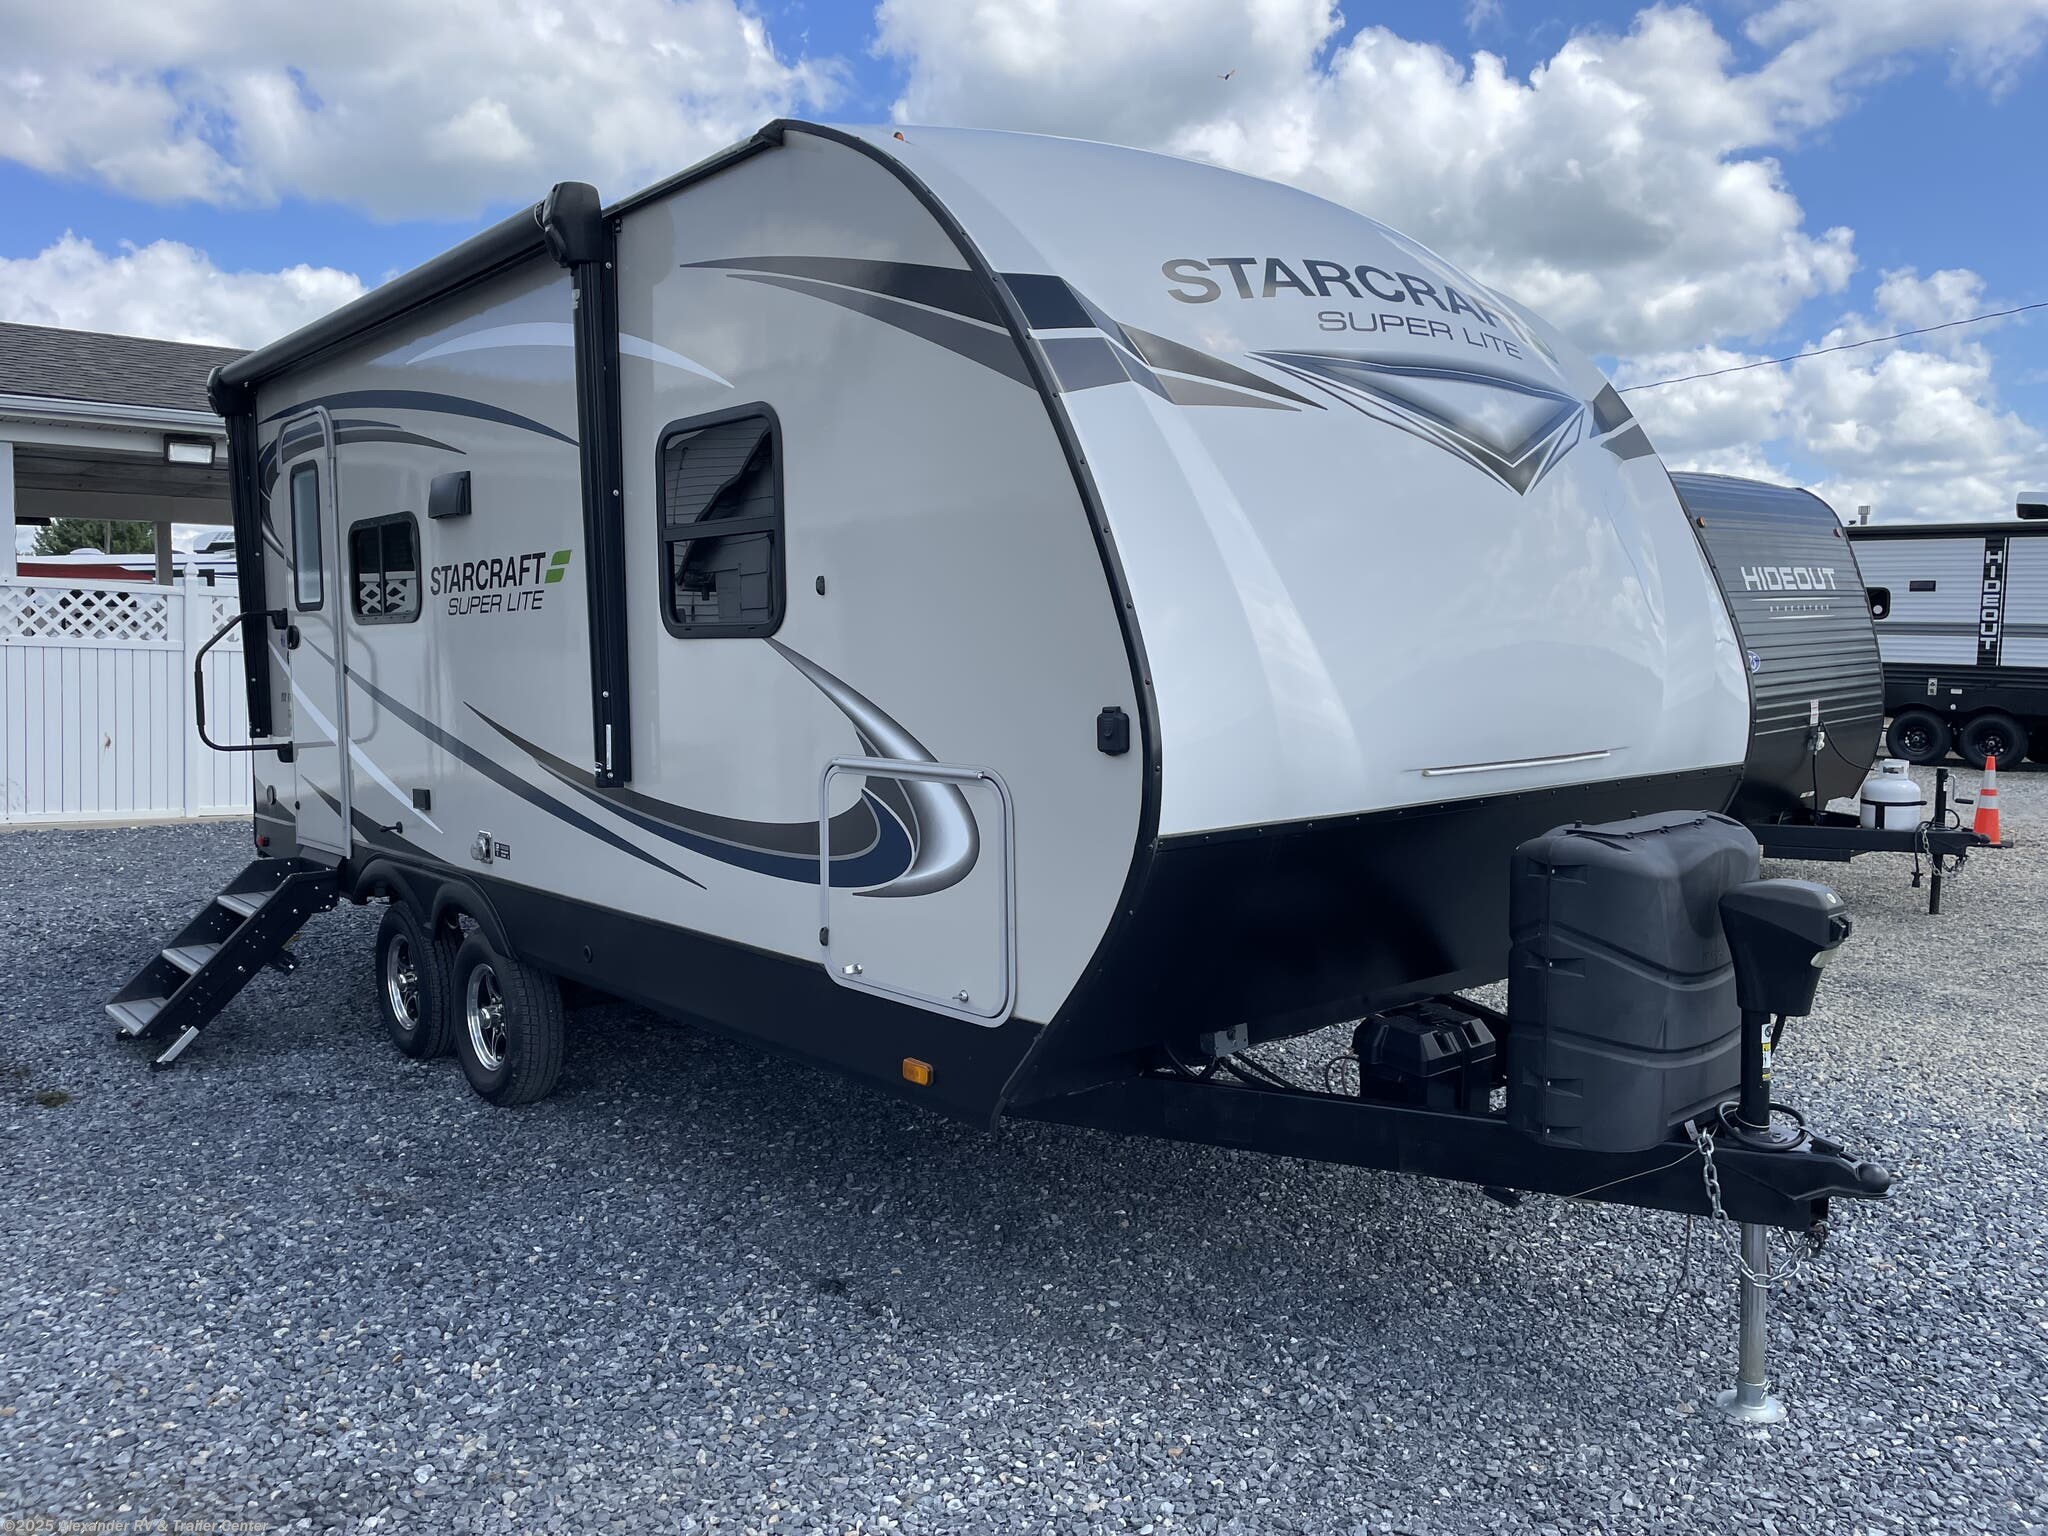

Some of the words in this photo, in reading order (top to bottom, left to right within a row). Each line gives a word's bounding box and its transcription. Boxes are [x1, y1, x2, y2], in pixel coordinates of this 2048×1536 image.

[1317, 310, 1454, 341] SUPER
[1462, 327, 1524, 361] LITE
[430, 551, 546, 596] STARCRAFT
[1740, 566, 1836, 591] HIDEOUT
[447, 594, 502, 616] SUPER
[507, 590, 545, 612] LITE
[1979, 550, 2003, 650] HIDEOUT
